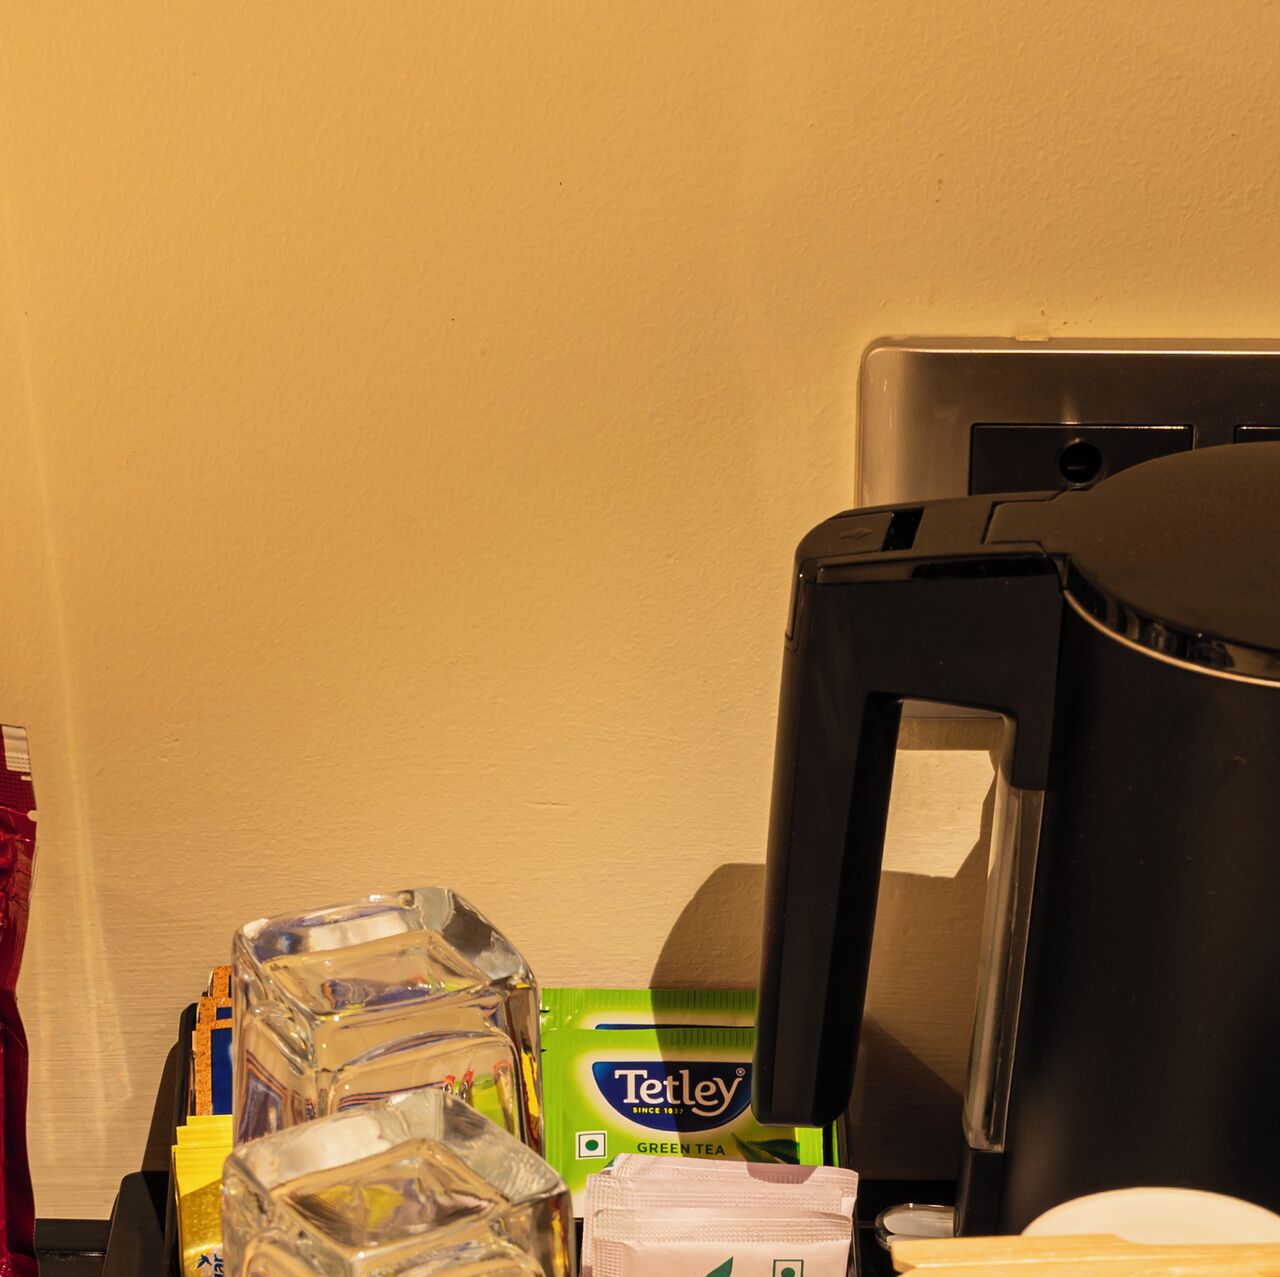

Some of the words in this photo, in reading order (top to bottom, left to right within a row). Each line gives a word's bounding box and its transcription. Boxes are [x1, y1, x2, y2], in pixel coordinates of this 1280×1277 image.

[614, 1069, 743, 1117] Tetley
[632, 1106, 661, 1115] SINCE
[664, 1106, 685, 1115] 1837
[637, 1142, 690, 1155] GREEN
[695, 1143, 726, 1156] TEA
